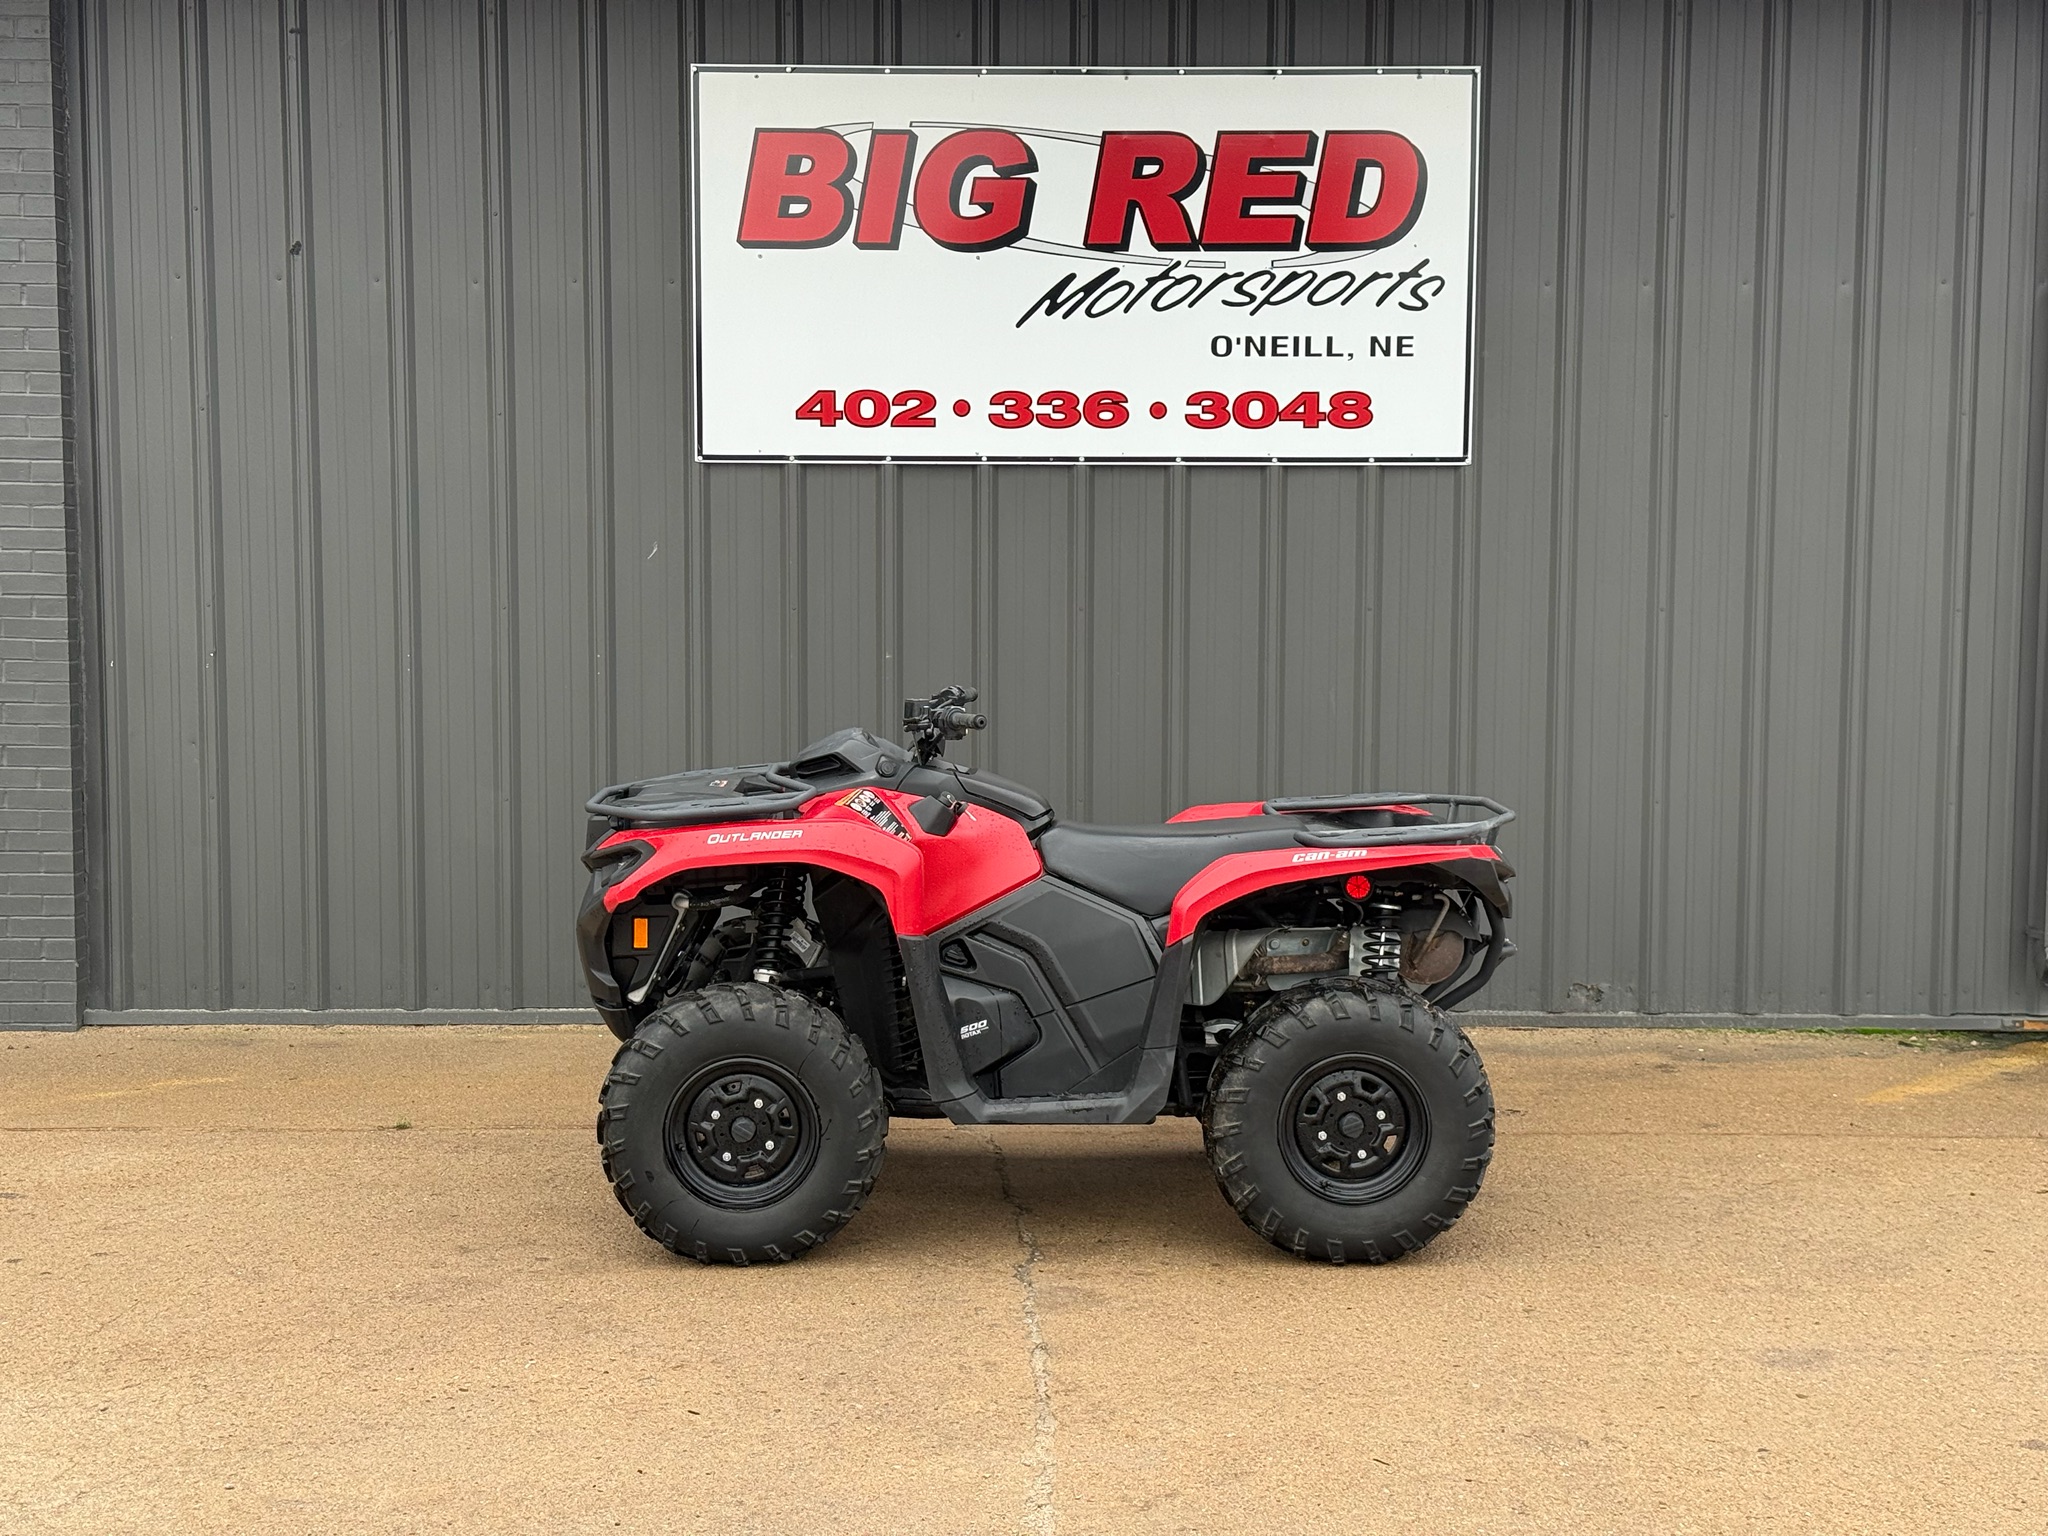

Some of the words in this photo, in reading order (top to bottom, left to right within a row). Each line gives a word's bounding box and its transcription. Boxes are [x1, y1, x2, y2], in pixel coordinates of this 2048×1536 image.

[736, 127, 1038, 250] BIG
[1083, 129, 1429, 252] RED
[1015, 258, 1446, 329] Motorsports
[1210, 335, 1355, 361] O'NEILL,
[1369, 335, 1415, 358] NE
[795, 389, 937, 429] 402
[987, 390, 1130, 430] 336
[1184, 390, 1374, 430] 3048
[707, 829, 803, 844] OUTLANDER
[1292, 849, 1368, 863] can-am
